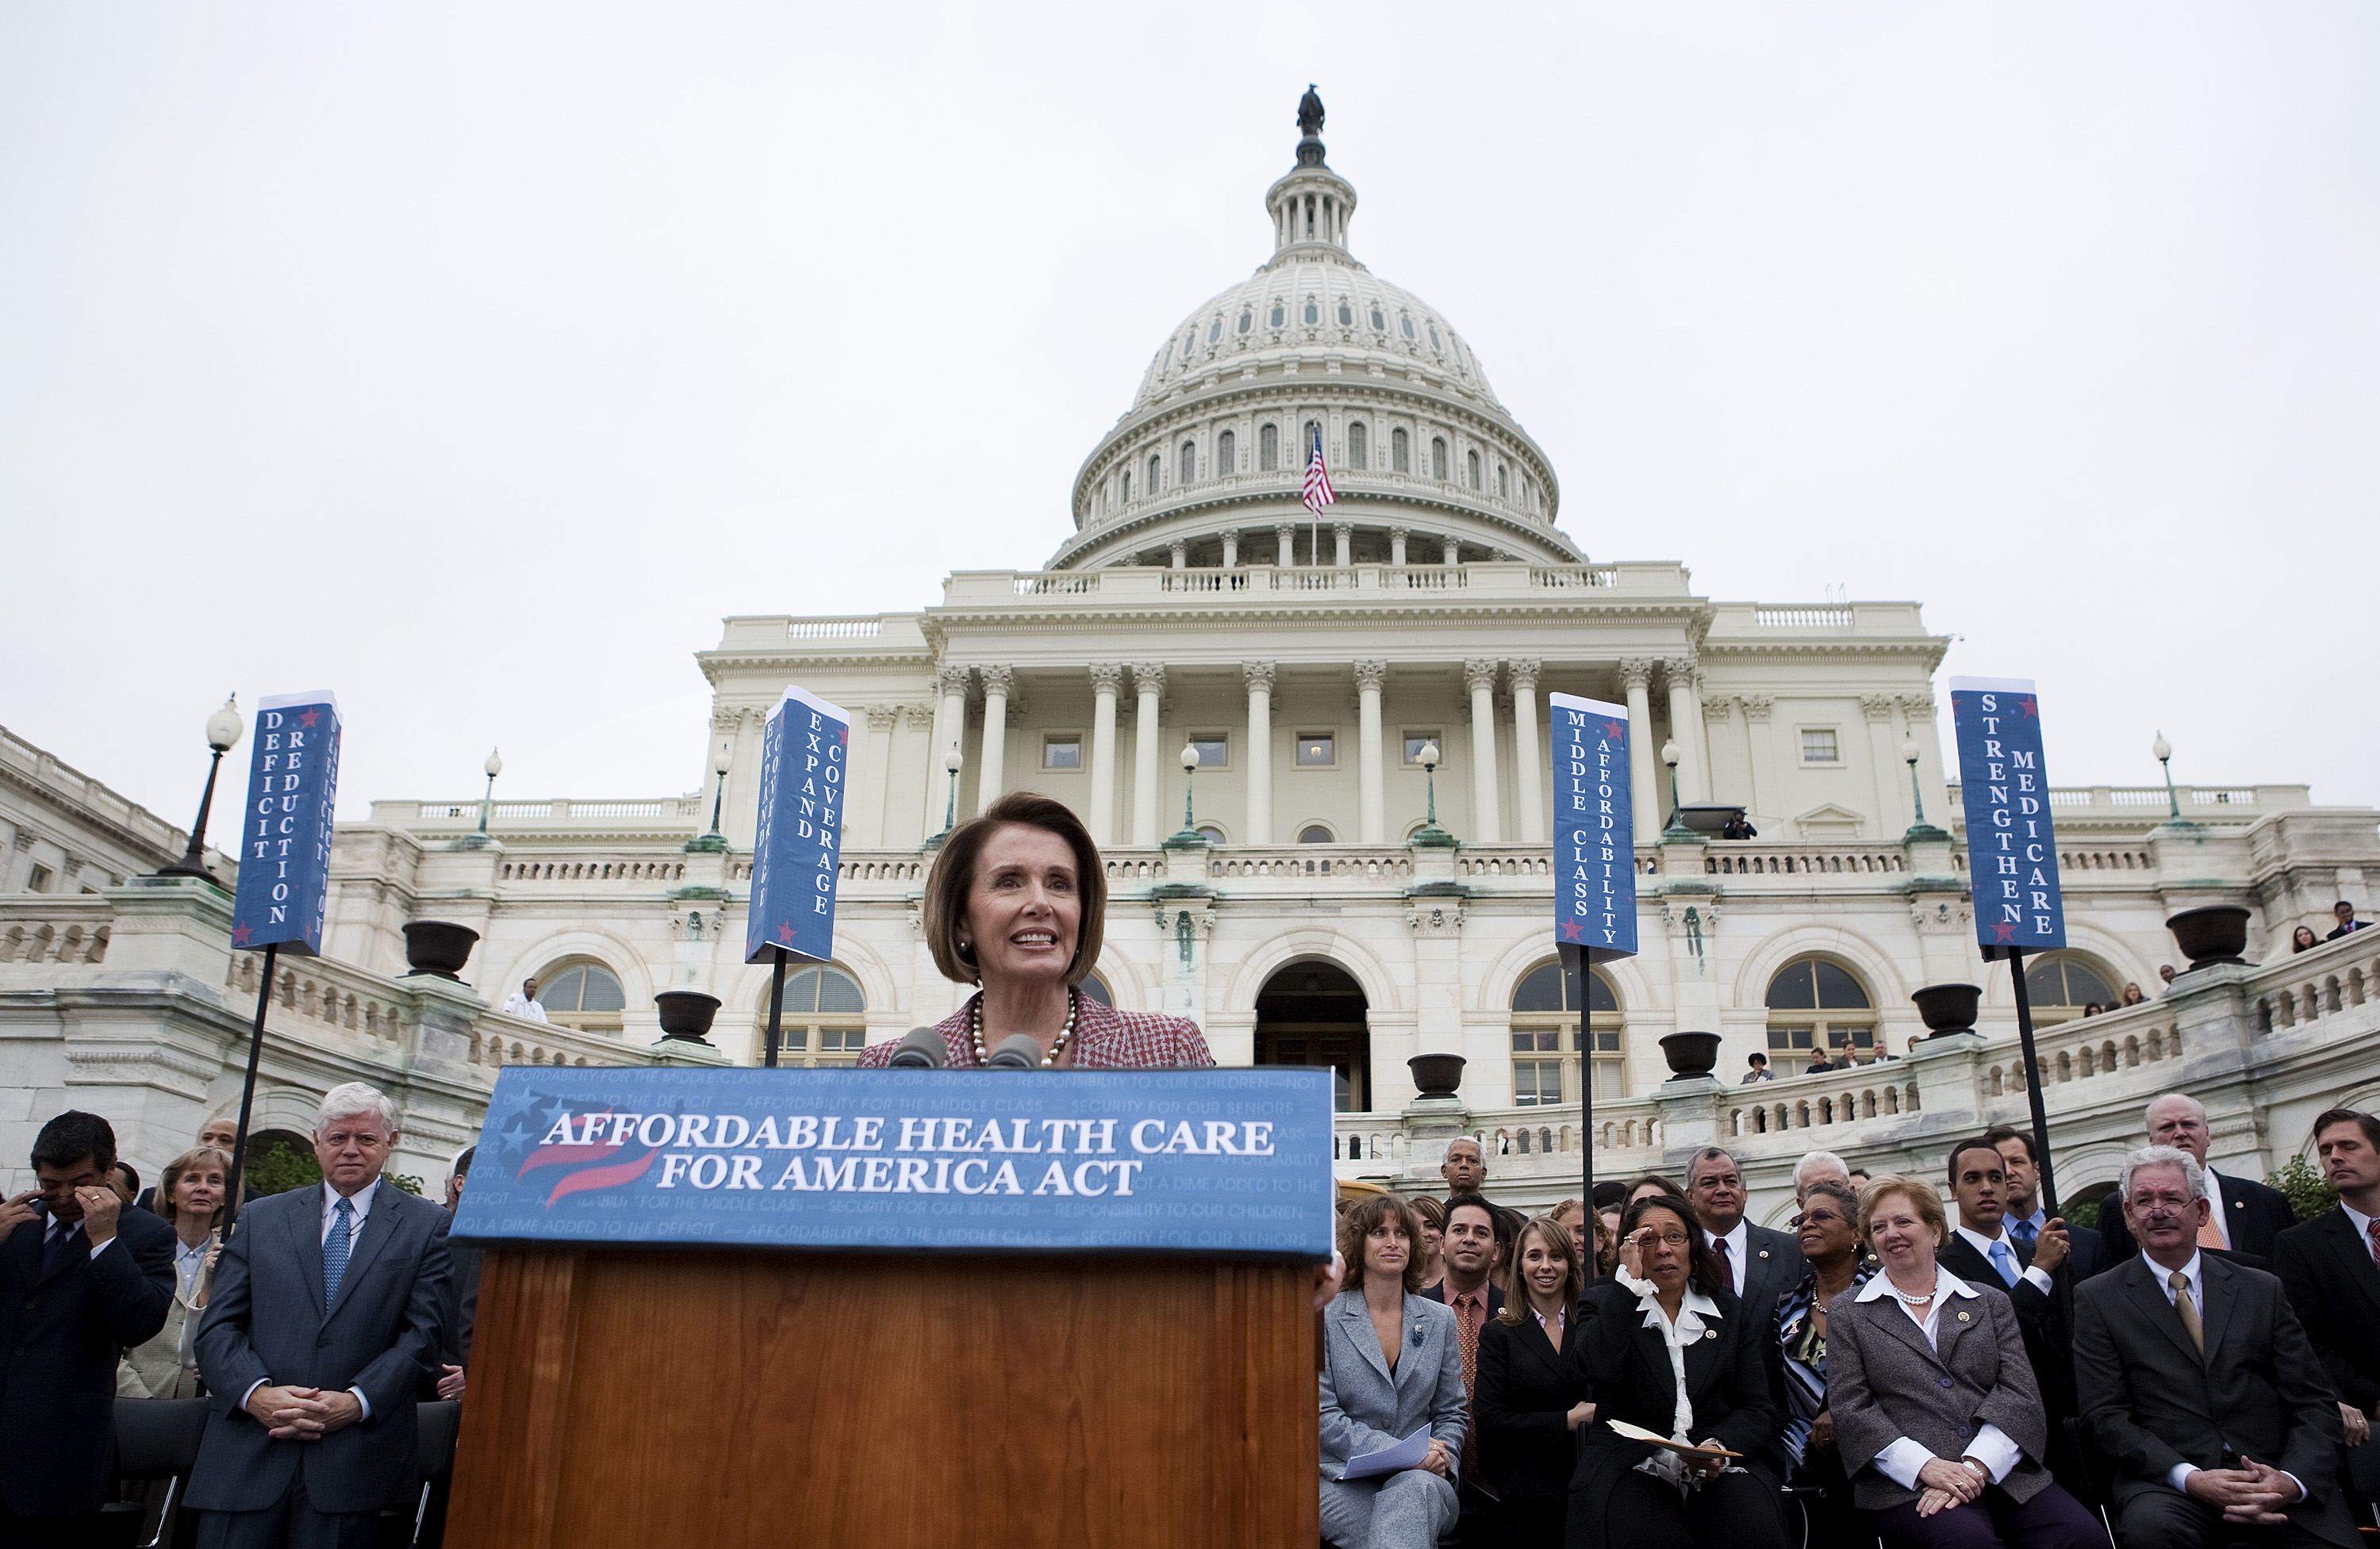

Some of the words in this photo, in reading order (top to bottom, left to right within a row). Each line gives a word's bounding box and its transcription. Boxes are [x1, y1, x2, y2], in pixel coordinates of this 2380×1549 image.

[254, 712, 283, 858] DEFICIT
[797, 711, 822, 838] EXPAND
[1568, 711, 1586, 811] MIDDLE
[1982, 694, 2021, 923] STRENGTHEN
[269, 731, 305, 924] REDUCTION
[813, 745, 841, 915] COVERAGE
[1572, 830, 1588, 916] CLASS
[1597, 738, 1616, 944] AFFORDABILITY
[2011, 750, 2052, 934] MEDICARE
[600, 1071, 631, 1083] FOR
[635, 1071, 660, 1083] THE
[662, 1072, 715, 1084] MIDDLE
[720, 1072, 765, 1085] CLASS
[789, 1073, 856, 1086] SECURITY
[858, 1073, 889, 1086] FOR
[893, 1074, 925, 1087] OUR
[929, 1074, 992, 1087] SENIORS
[1017, 1074, 1127, 1088] RESPONSIBILITY
[1132, 1076, 1152, 1089] TO
[1156, 1076, 1189, 1089] OUR
[743, 1096, 857, 1110] AFFORDABILITY
[861, 1097, 893, 1110] FOR
[899, 1098, 925, 1111] THE
[931, 1098, 986, 1112] MIDDLE
[994, 1098, 1042, 1112] CLASS
[1071, 1099, 1143, 1114] SECURITY
[1148, 1100, 1180, 1114] FOR
[1186, 1101, 1221, 1114] OUR
[1226, 1101, 1294, 1115] SENIORS
[539, 1112, 885, 1151] AFFORDABLE
[894, 1117, 1119, 1154] HEALTH
[1130, 1119, 1275, 1156] CARE
[656, 1153, 765, 1191] FOR
[770, 1156, 1025, 1195] AMERICA
[1032, 1159, 1143, 1197] ACT
[501, 1218, 540, 1232] DIME
[543, 1219, 597, 1234] ADDED
[603, 1221, 622, 1234] TO
[628, 1221, 653, 1236] THE
[657, 1221, 716, 1237] DEFICIT
[745, 1224, 862, 1240] AFFORDABILITY
[866, 1225, 900, 1240] FOR
[904, 1227, 932, 1242] THE
[937, 1228, 996, 1243] MIDDLE
[1002, 1229, 1052, 1244] CLASS
[1081, 1229, 1150, 1245] SECURITY
[1158, 1230, 1191, 1245] FOR
[1198, 1230, 1233, 1246] OUR
[1239, 1231, 1308, 1247] SENIORS
[701, 1196, 756, 1212] MIDDLE
[758, 1198, 804, 1213] CLASS
[827, 1198, 893, 1214] SECURITY
[896, 1200, 927, 1215] FOR
[931, 1201, 964, 1215] OUR
[967, 1202, 1030, 1217] SENIORS
[1054, 1202, 1163, 1217] RESPONSIBILITY
[1167, 1202, 1187, 1217] TO
[1191, 1203, 1224, 1218] OUR
